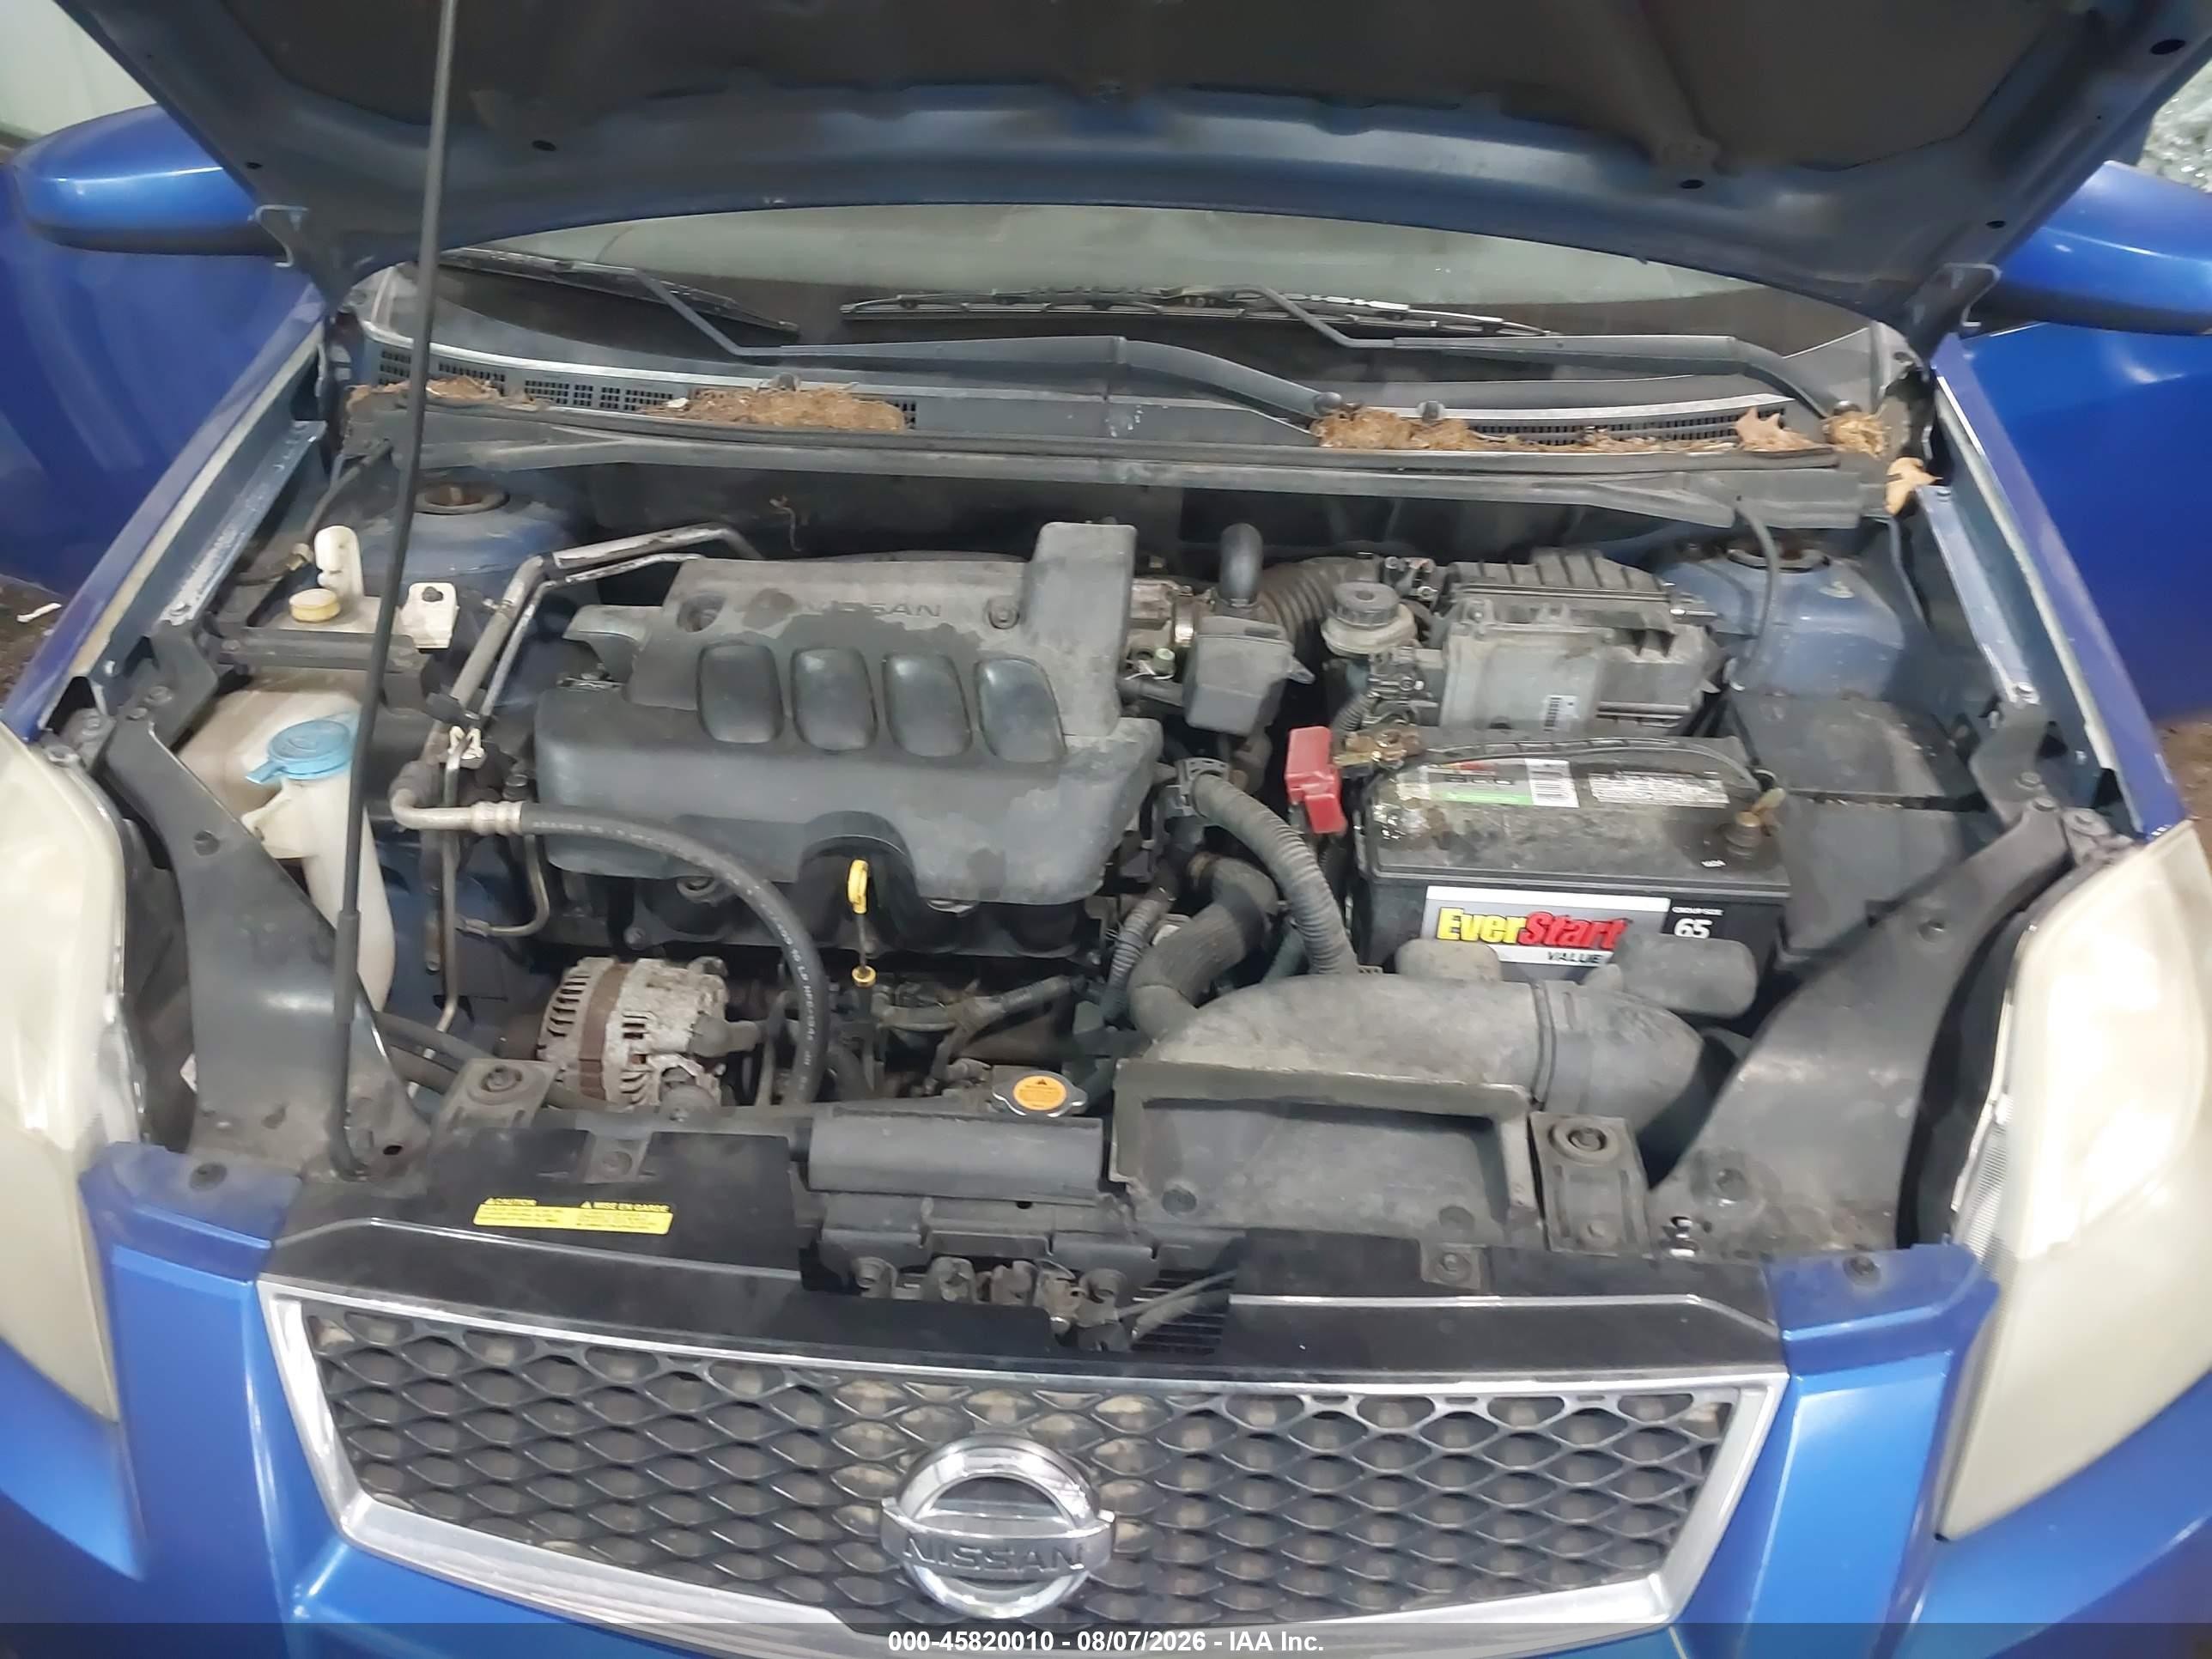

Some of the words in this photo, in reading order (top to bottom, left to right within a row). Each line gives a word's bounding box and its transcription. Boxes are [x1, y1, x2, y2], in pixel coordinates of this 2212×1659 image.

[1436, 906, 1627, 950] EverStart
[1674, 917, 1713, 939] 65
[1547, 951, 1603, 963] VALUE
[902, 1537, 1085, 1574] NISSAN
